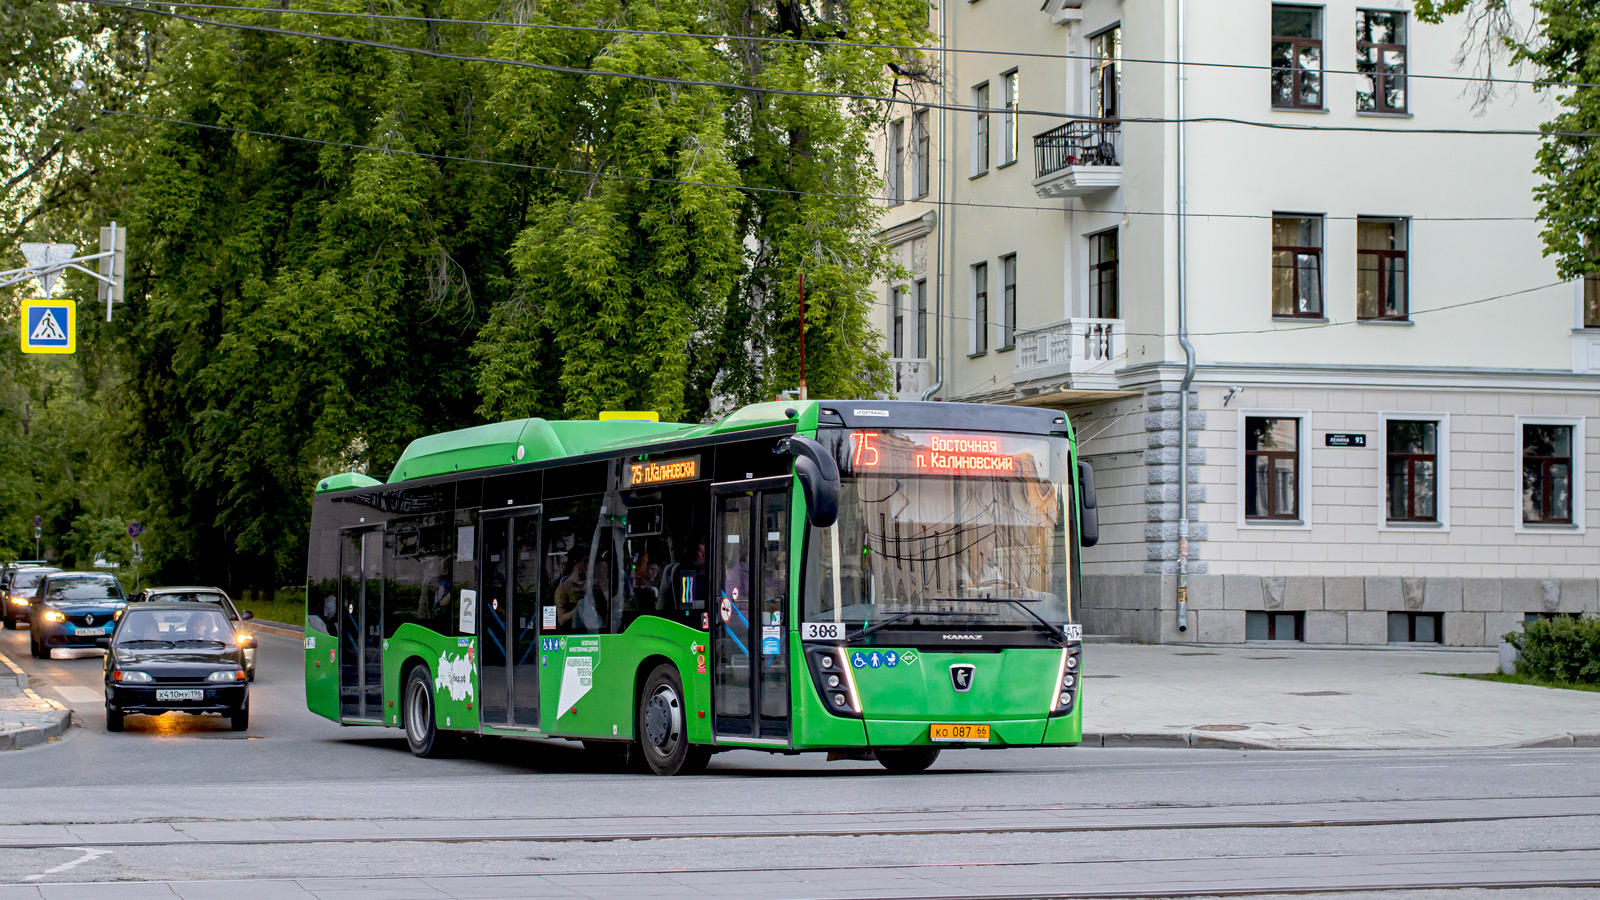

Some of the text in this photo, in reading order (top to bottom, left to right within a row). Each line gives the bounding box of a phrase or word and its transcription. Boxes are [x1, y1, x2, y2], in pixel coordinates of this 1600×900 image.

[849, 433, 879, 466] 75
[931, 436, 997, 453] Восточная
[916, 452, 1013, 470] п. Калиновский
[631, 464, 643, 484] 75
[809, 624, 838, 638] 308
[935, 728, 949, 737] КО
[952, 726, 972, 738] 087
[976, 726, 987, 735] 66
